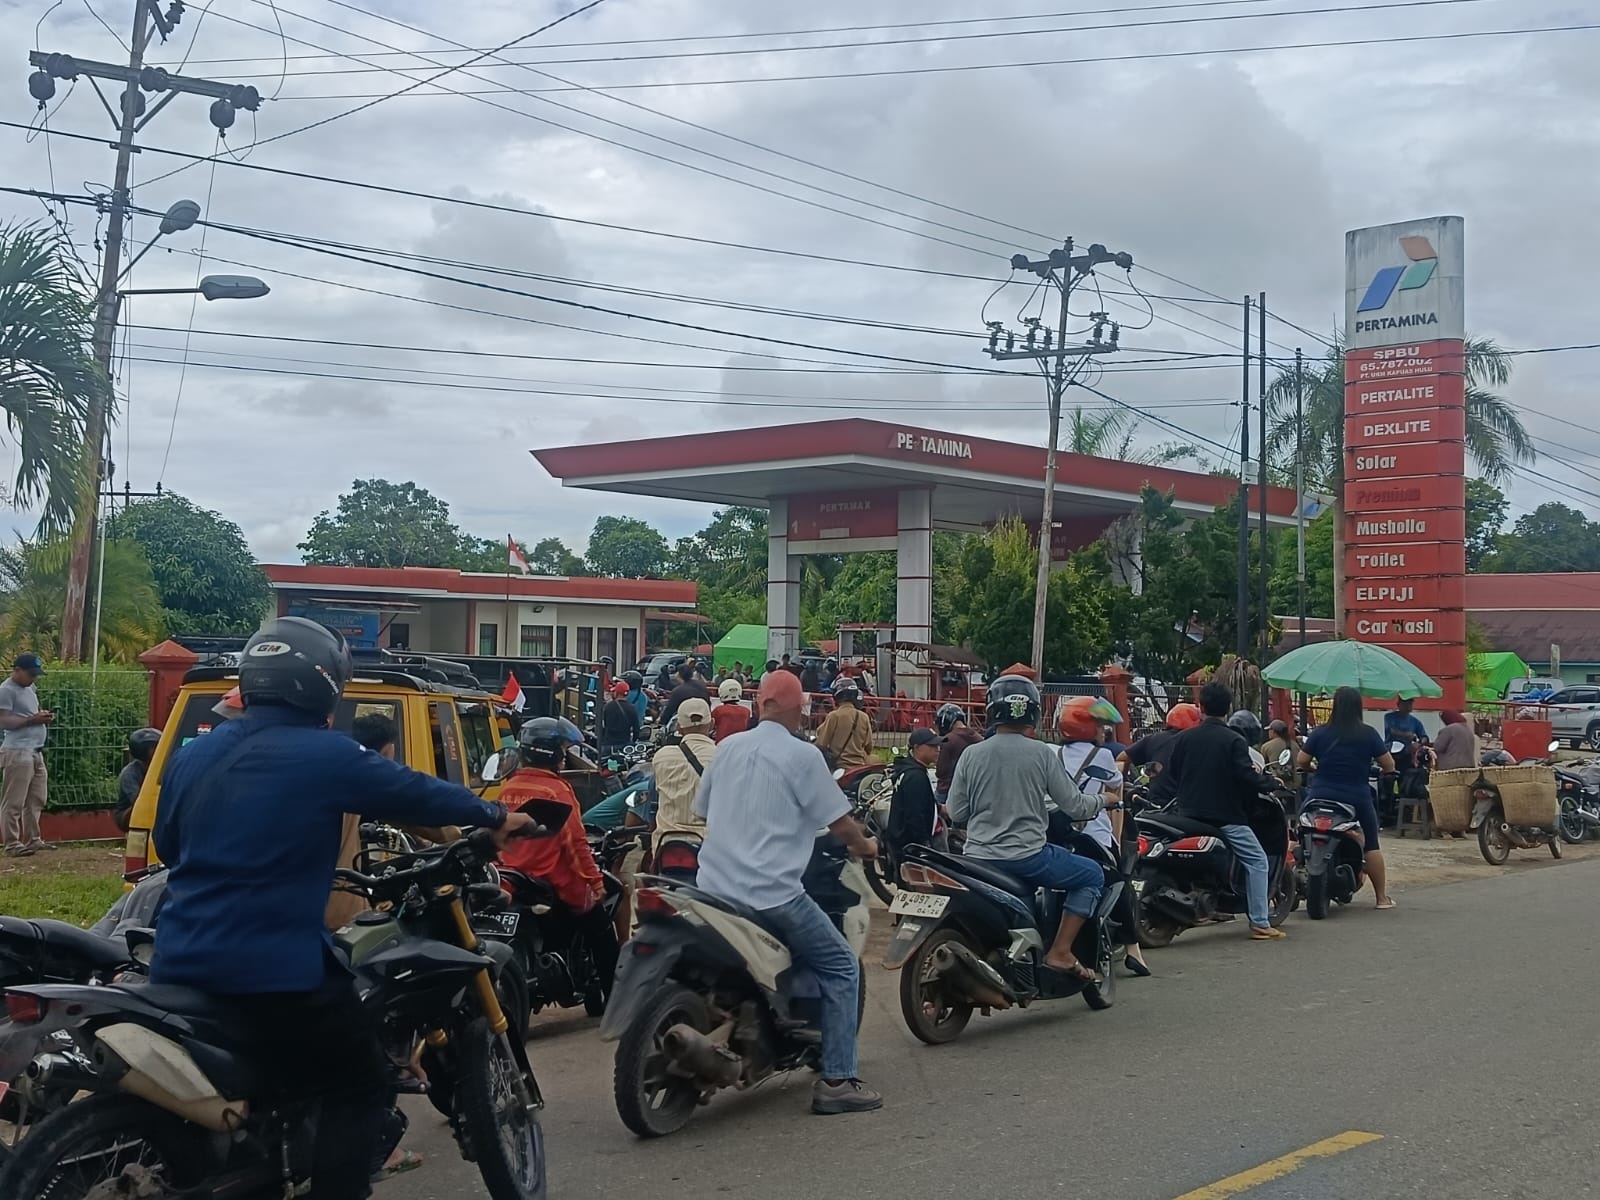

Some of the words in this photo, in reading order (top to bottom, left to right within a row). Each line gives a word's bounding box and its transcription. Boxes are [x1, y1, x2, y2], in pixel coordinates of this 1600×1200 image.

[1356, 312, 1438, 333] PERTAMINA
[1373, 346, 1420, 359] SPBU
[1360, 358, 1433, 372] 65.787.002
[1360, 386, 1434, 405] PERTALITE
[1363, 420, 1431, 437] DEXLITE
[1356, 455, 1397, 471] Solar
[1356, 487, 1421, 504] Premium
[1356, 519, 1426, 536] Musholla
[1356, 552, 1406, 568] Toilet
[1356, 587, 1414, 602] ELPIJI
[1357, 619, 1388, 635] Car
[257, 644, 282, 652] GM
[894, 891, 908, 902] KB
